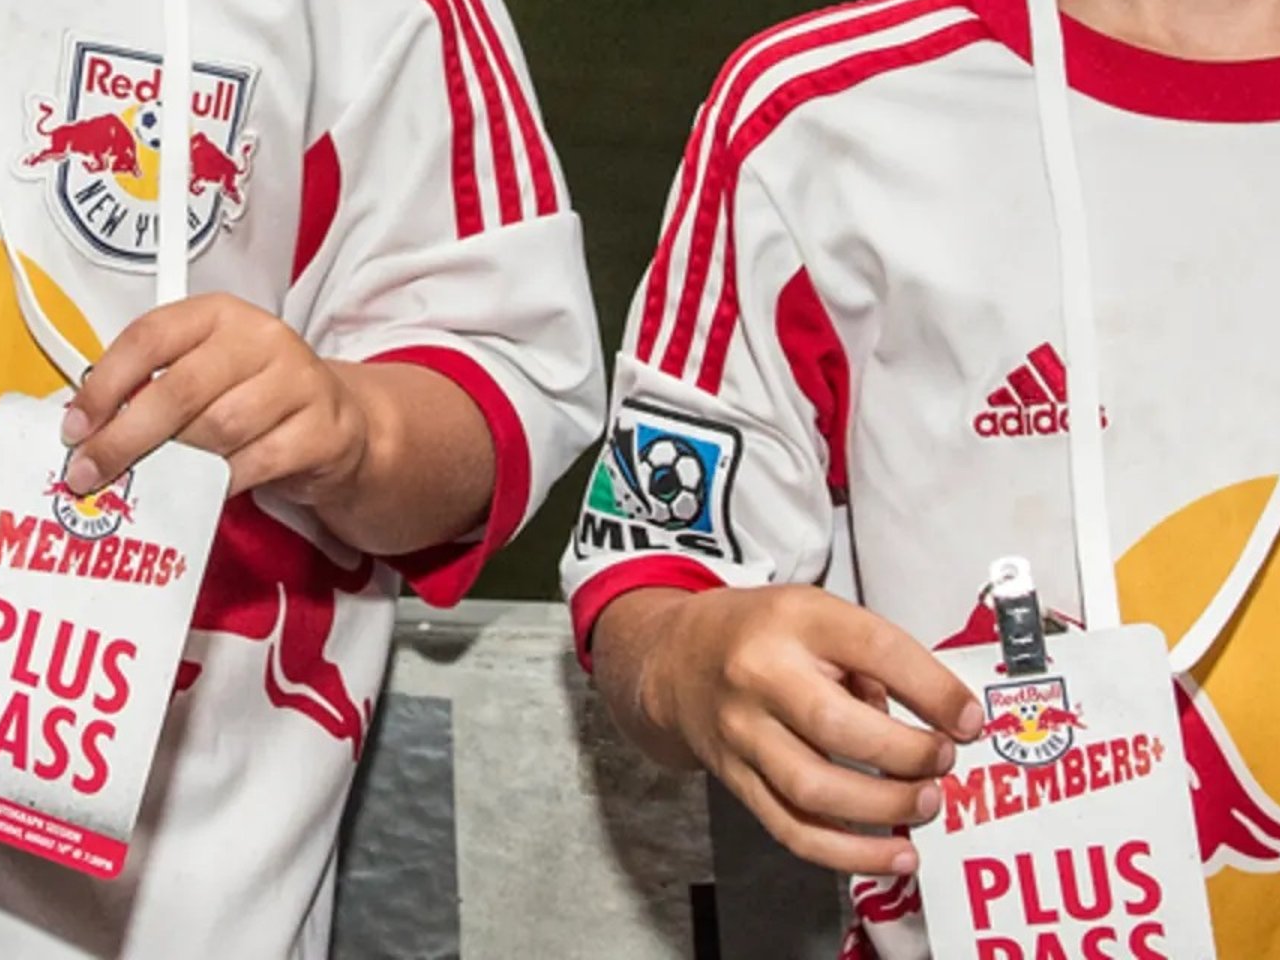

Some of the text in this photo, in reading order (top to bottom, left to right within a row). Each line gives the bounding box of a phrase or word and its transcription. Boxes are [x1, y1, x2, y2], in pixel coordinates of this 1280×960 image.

[85, 56, 236, 122] Red ull
[73, 178, 128, 239] NEW
[973, 401, 1108, 438] adid
[962, 839, 1163, 931] PLUS
